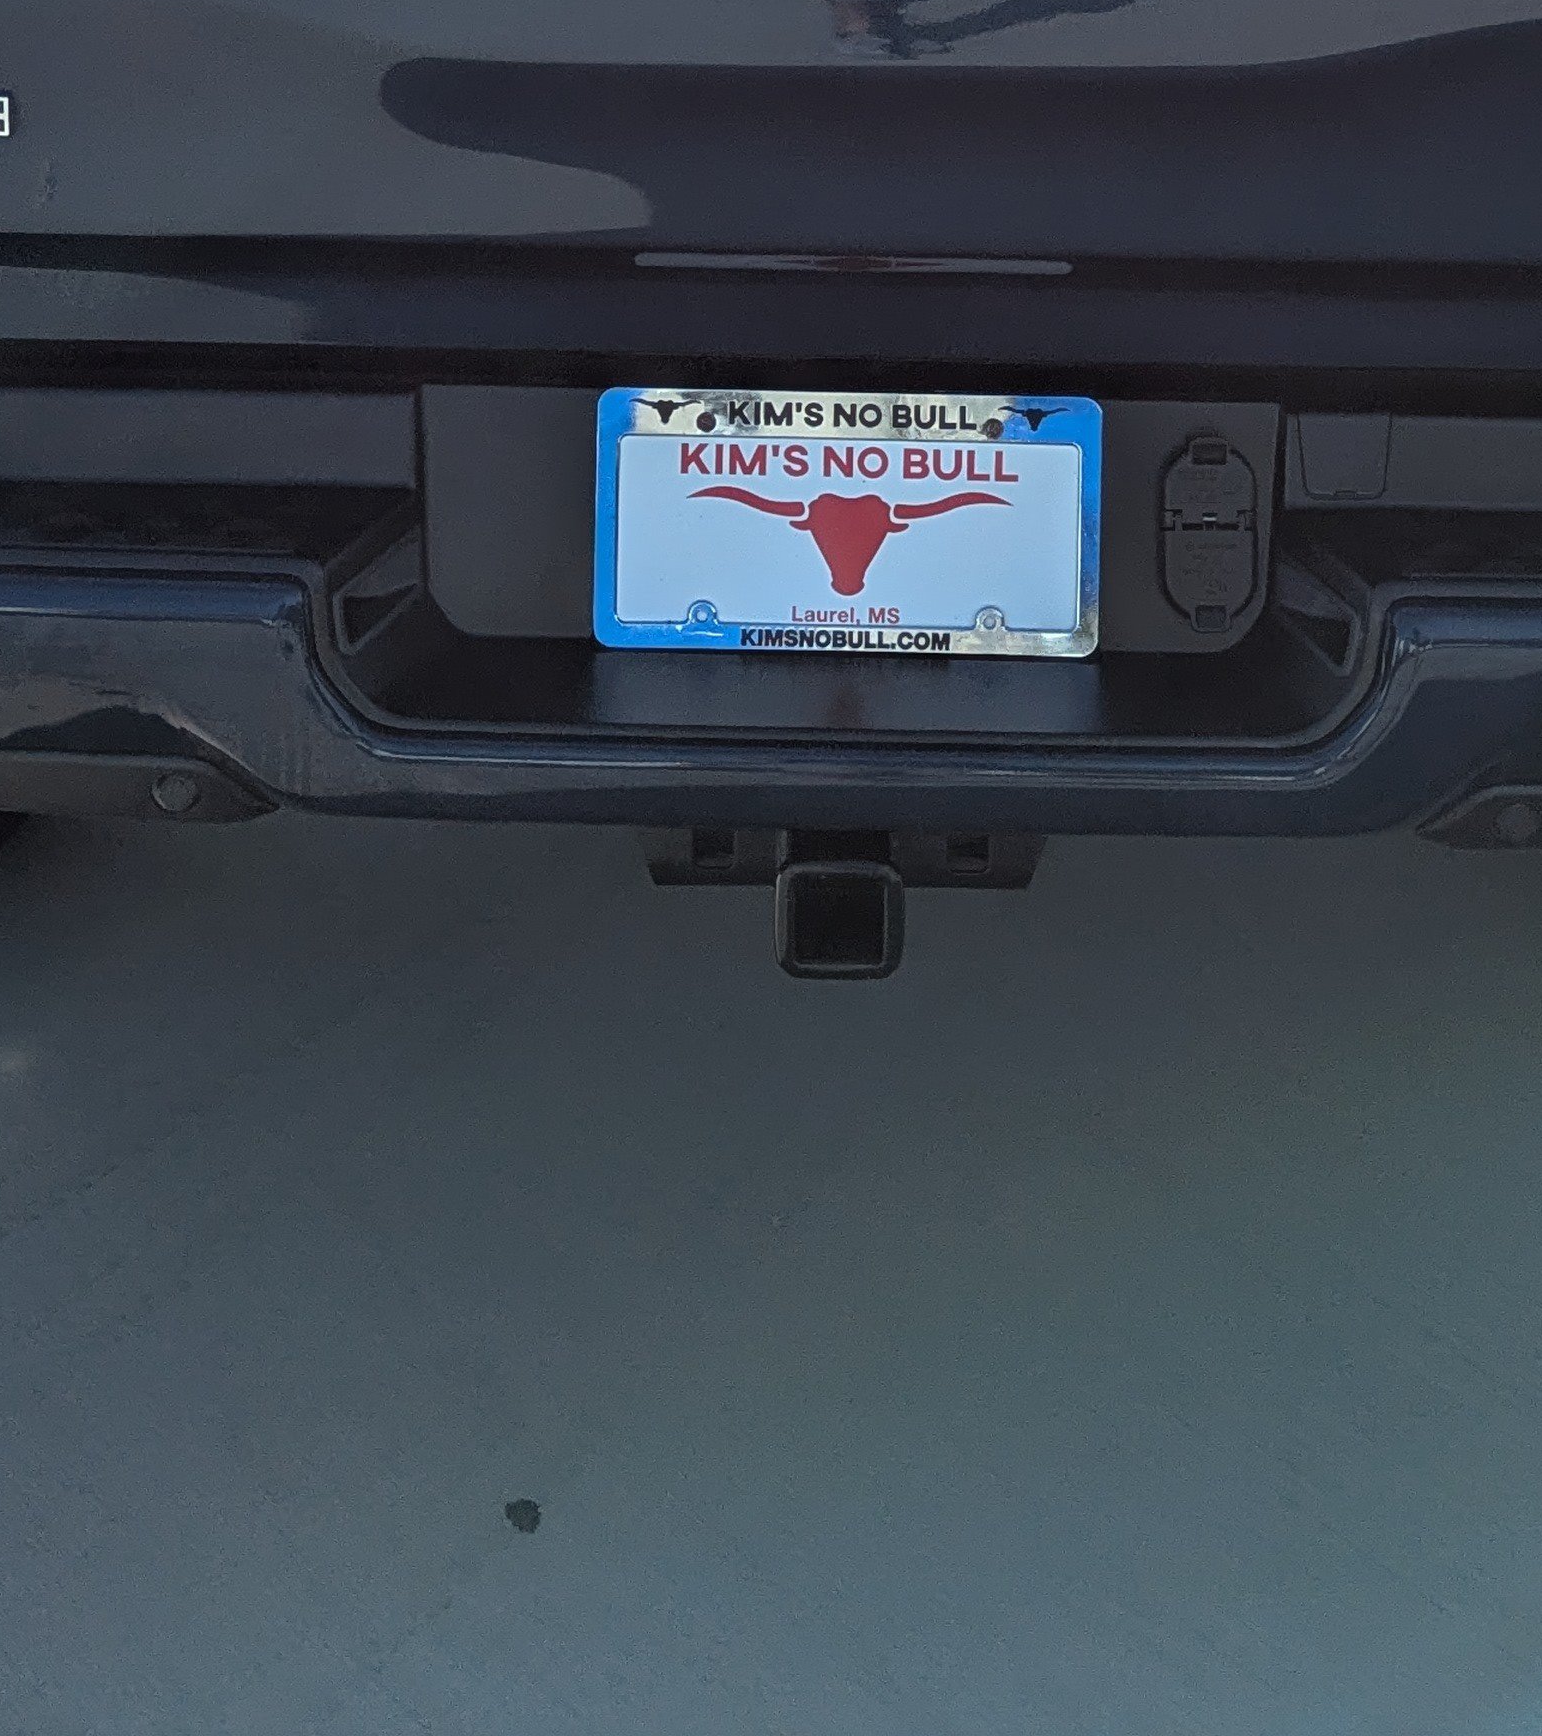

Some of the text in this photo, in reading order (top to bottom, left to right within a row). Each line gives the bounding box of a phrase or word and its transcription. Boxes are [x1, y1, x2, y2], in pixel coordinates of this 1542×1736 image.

[727, 400, 977, 431] KIM'S NO BULL
[679, 442, 1020, 483] KIM'S NO BULL
[790, 605, 901, 626] Laurel, MS
[739, 628, 951, 652] KIMSNOBULL.COM
